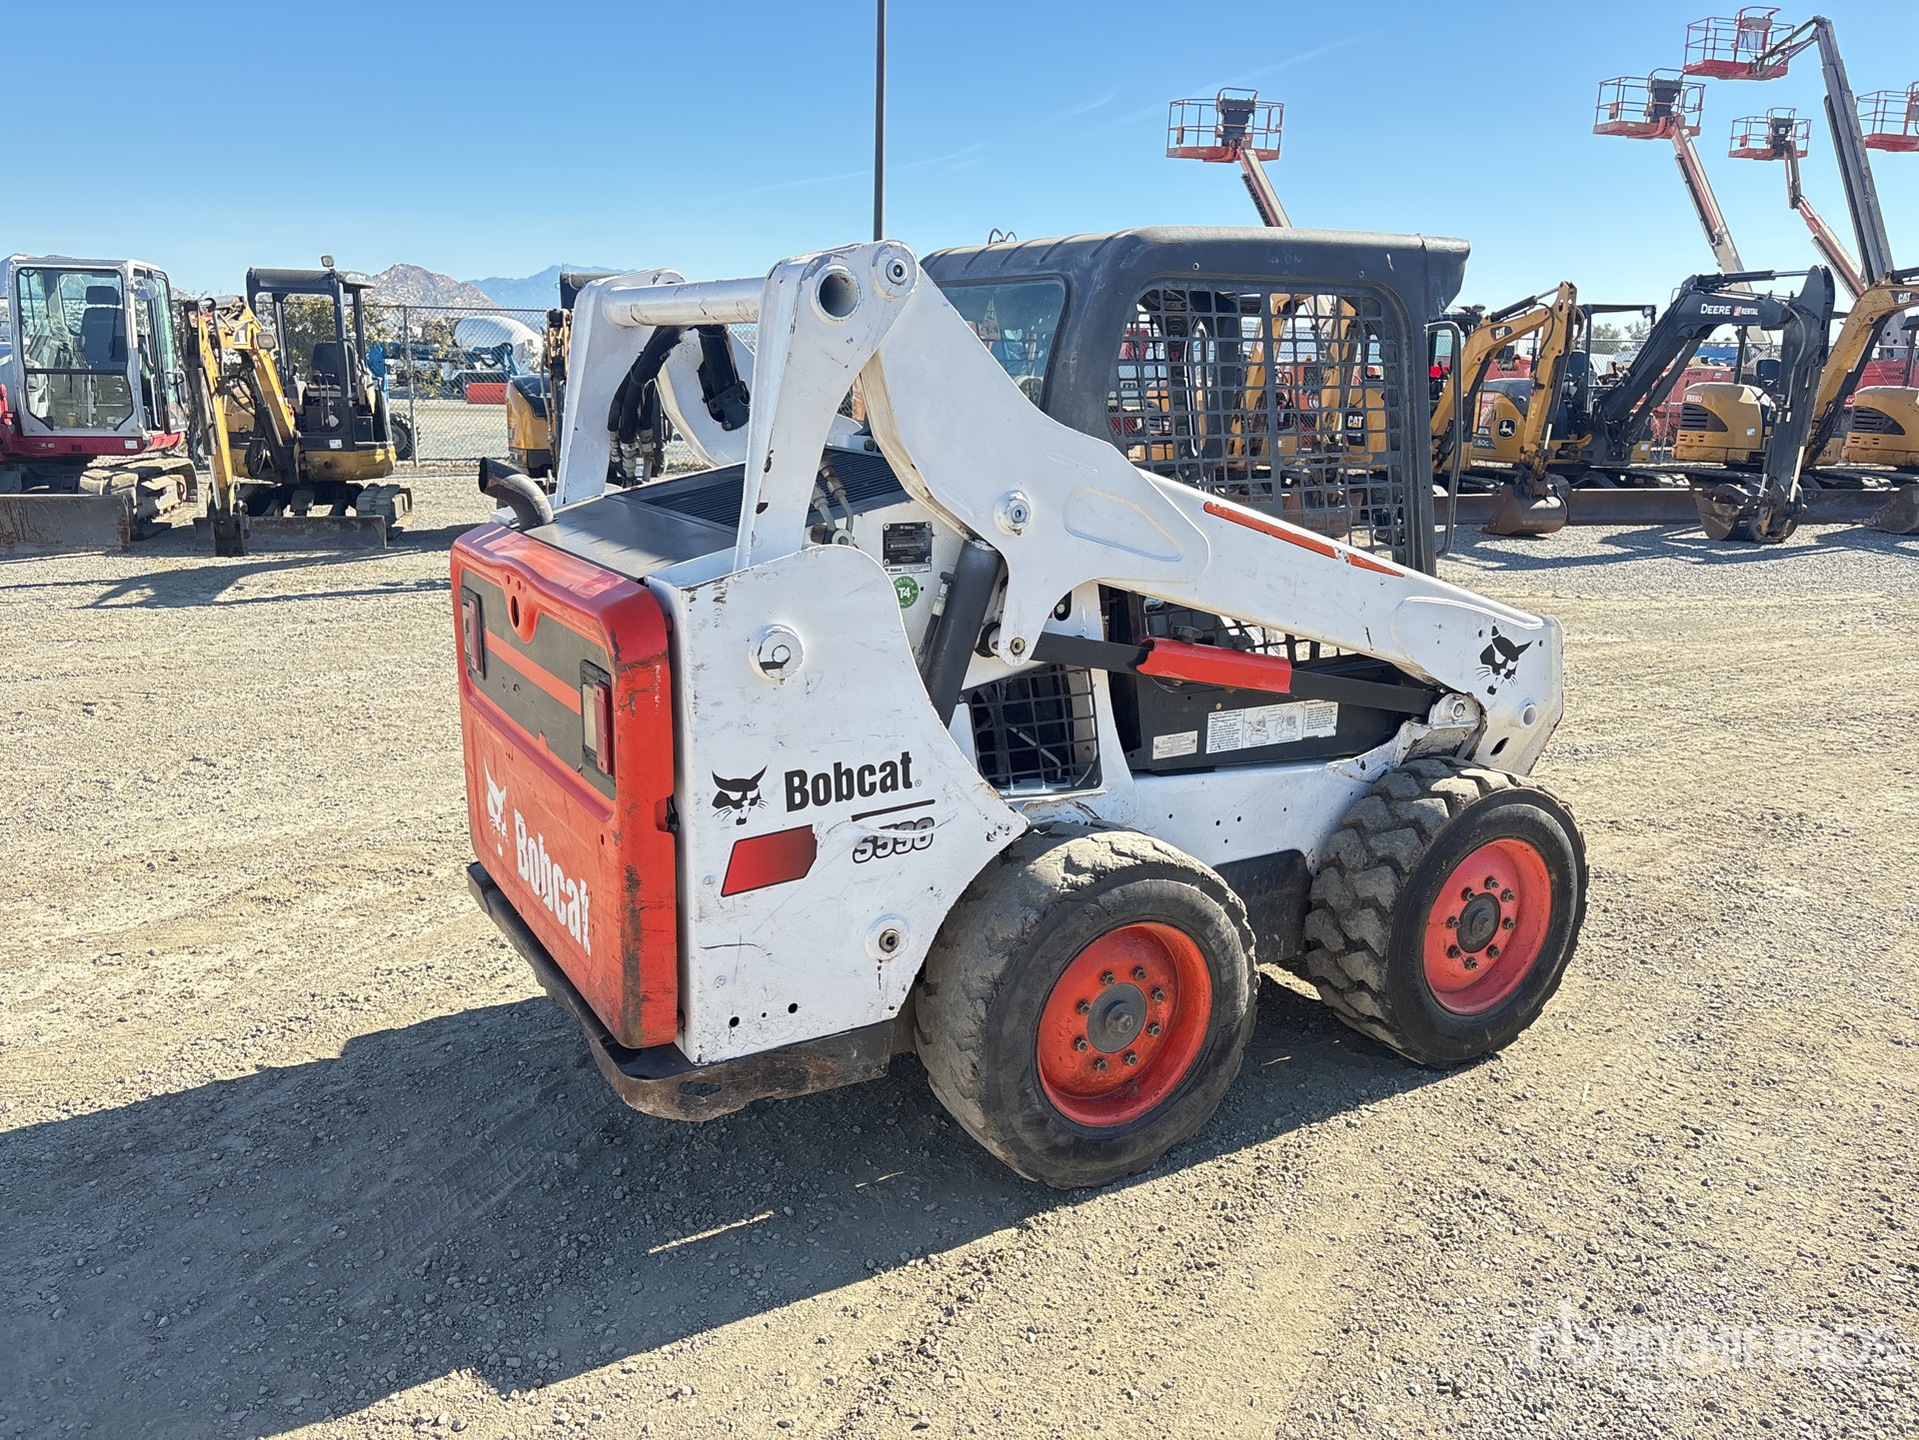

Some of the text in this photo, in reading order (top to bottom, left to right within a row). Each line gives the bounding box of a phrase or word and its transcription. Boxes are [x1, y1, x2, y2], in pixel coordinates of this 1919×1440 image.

[1897, 292, 1911, 304] CAT
[1700, 303, 1732, 315] DEERE
[1495, 326, 1506, 340] CAT
[1347, 415, 1364, 428] CAT
[896, 587, 912, 599] T4
[785, 751, 913, 813] Bobcat
[514, 808, 592, 957] Bobcat
